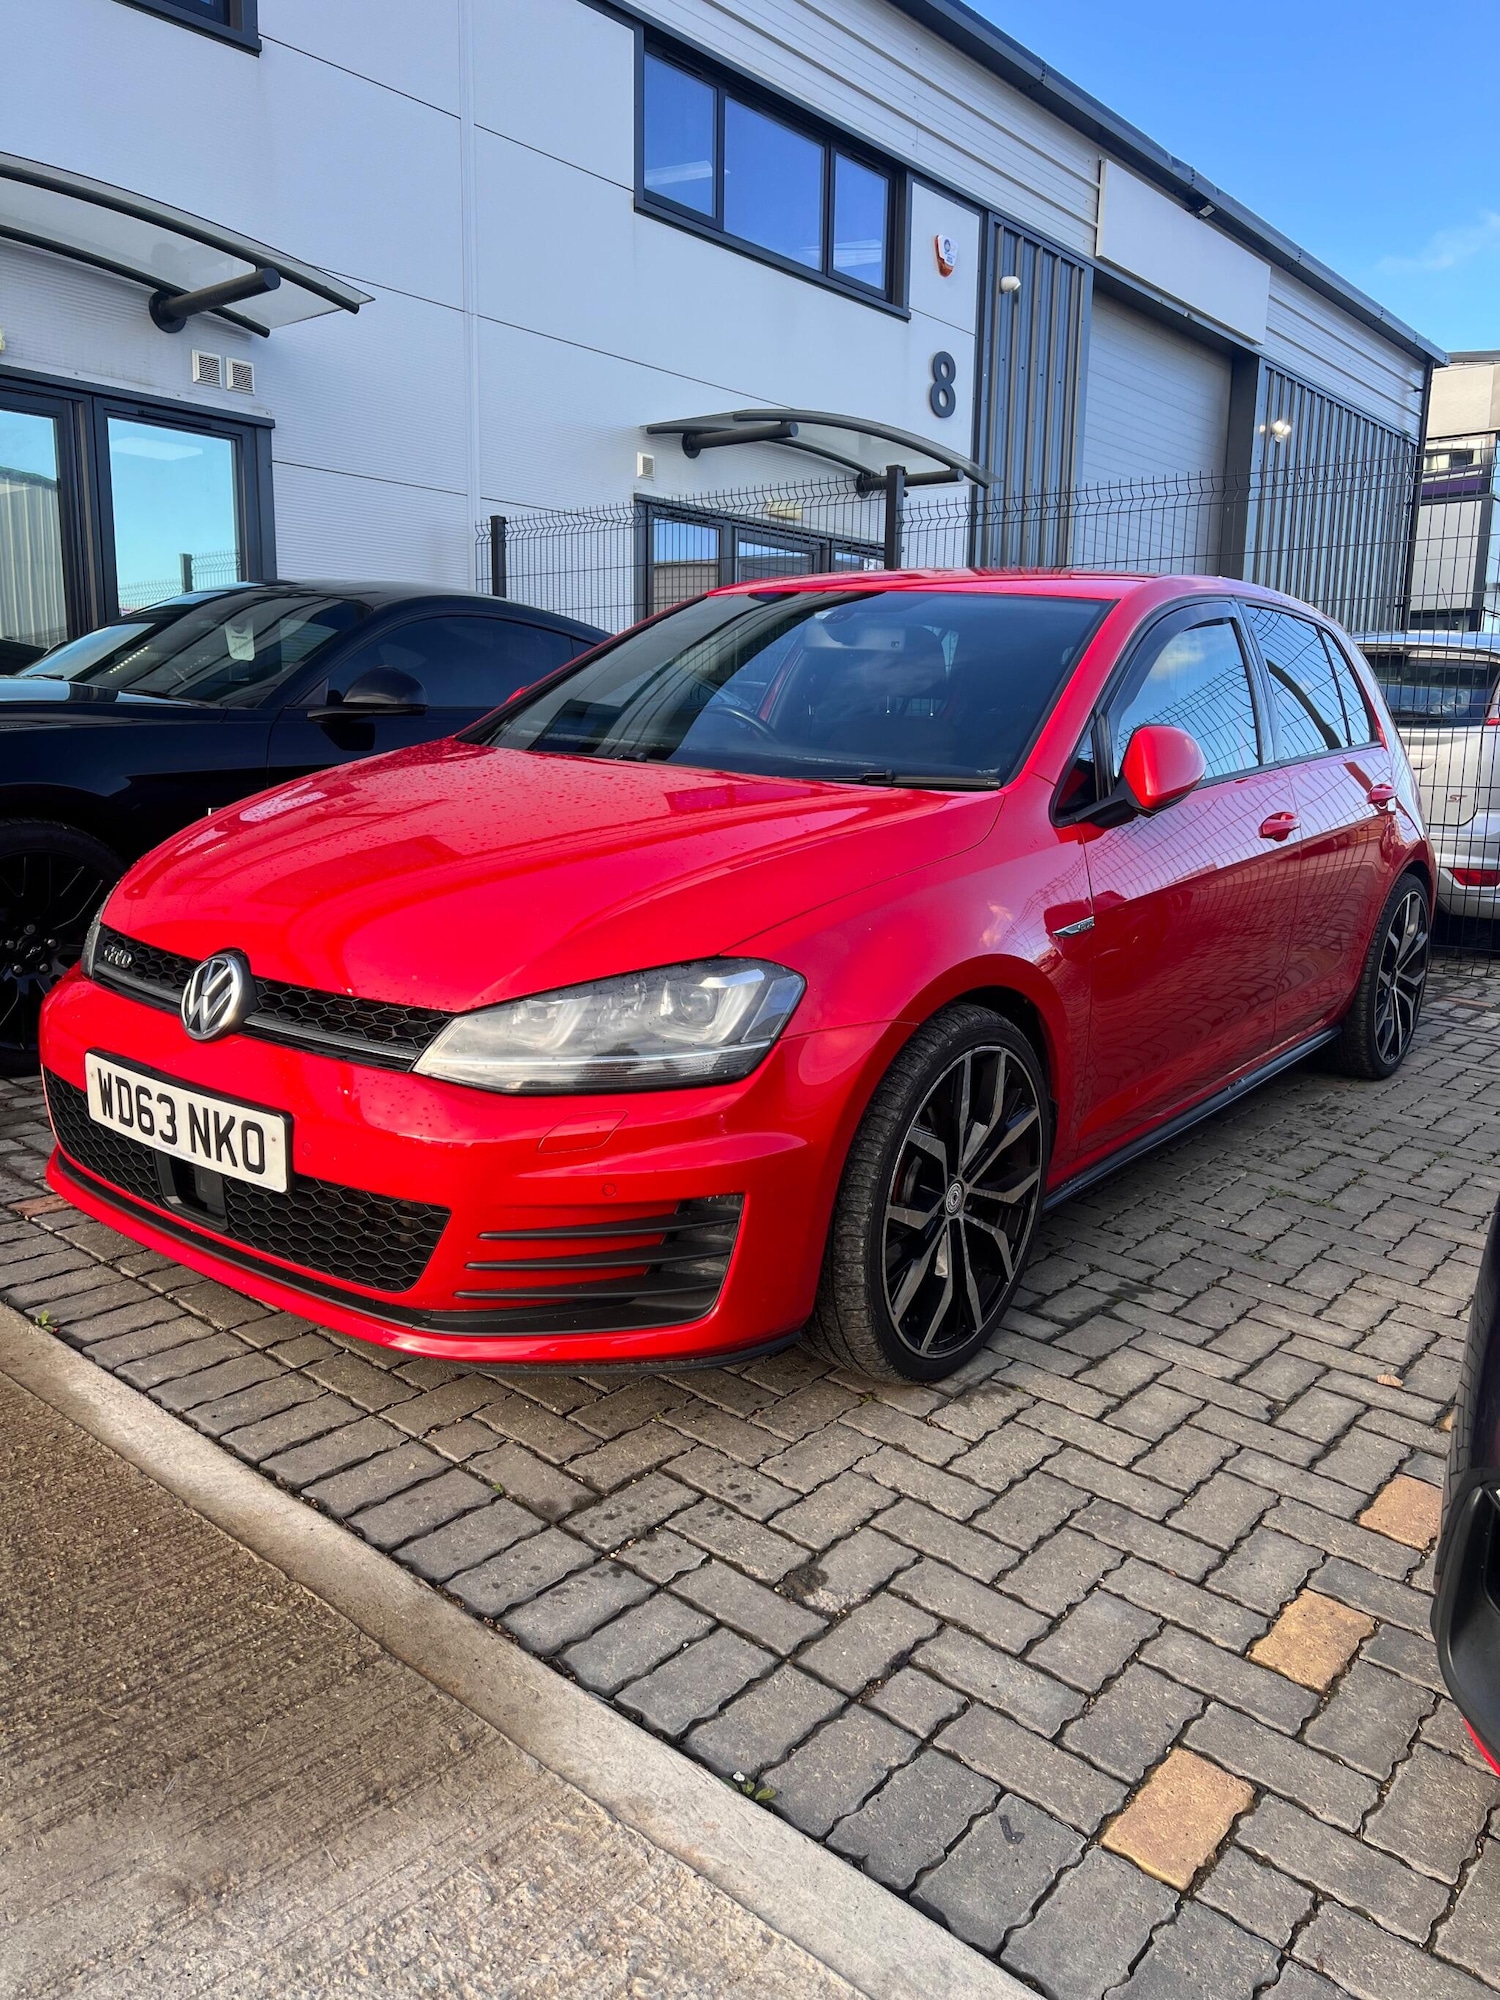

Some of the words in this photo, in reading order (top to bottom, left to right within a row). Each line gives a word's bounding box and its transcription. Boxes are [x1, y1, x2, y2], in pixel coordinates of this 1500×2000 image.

[930, 351, 956, 418] 8
[97, 1068, 178, 1146] WD63
[188, 1102, 266, 1175] NKO
